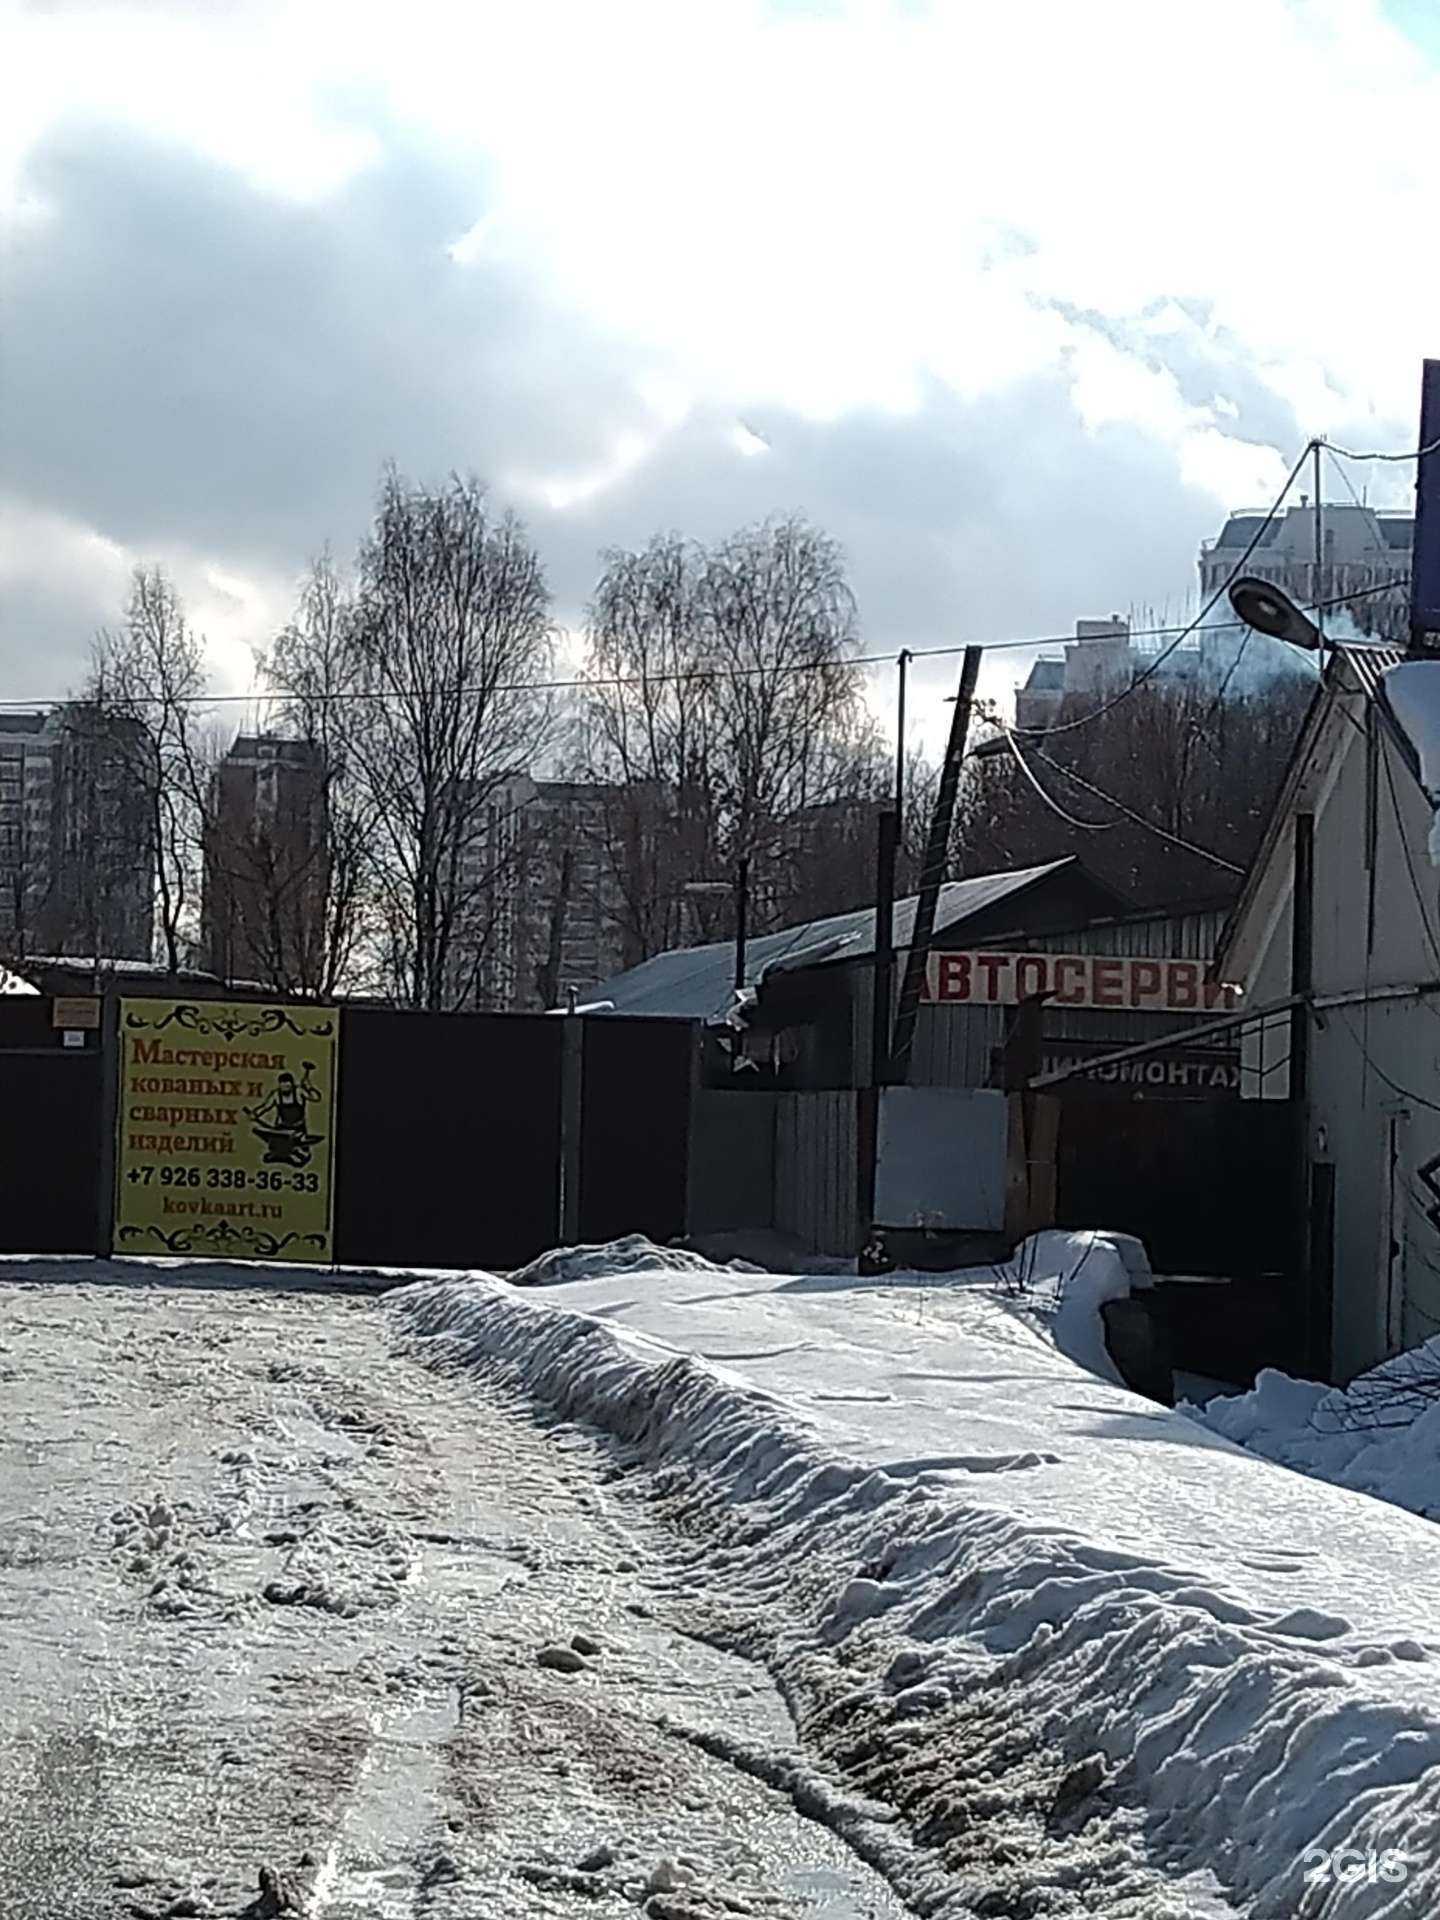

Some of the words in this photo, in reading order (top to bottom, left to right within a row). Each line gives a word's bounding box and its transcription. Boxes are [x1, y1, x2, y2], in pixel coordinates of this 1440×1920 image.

[130, 1038, 286, 1071] Мастерская
[130, 1075, 243, 1098] кованых
[248, 1081, 263, 1098] и
[129, 1103, 238, 1128] сварных
[128, 1132, 234, 1155] изделий
[126, 1166, 155, 1186] +7
[160, 1168, 200, 1187] 926
[206, 1168, 319, 1192] 338-36-33
[163, 1197, 282, 1219] kovkaart.ru
